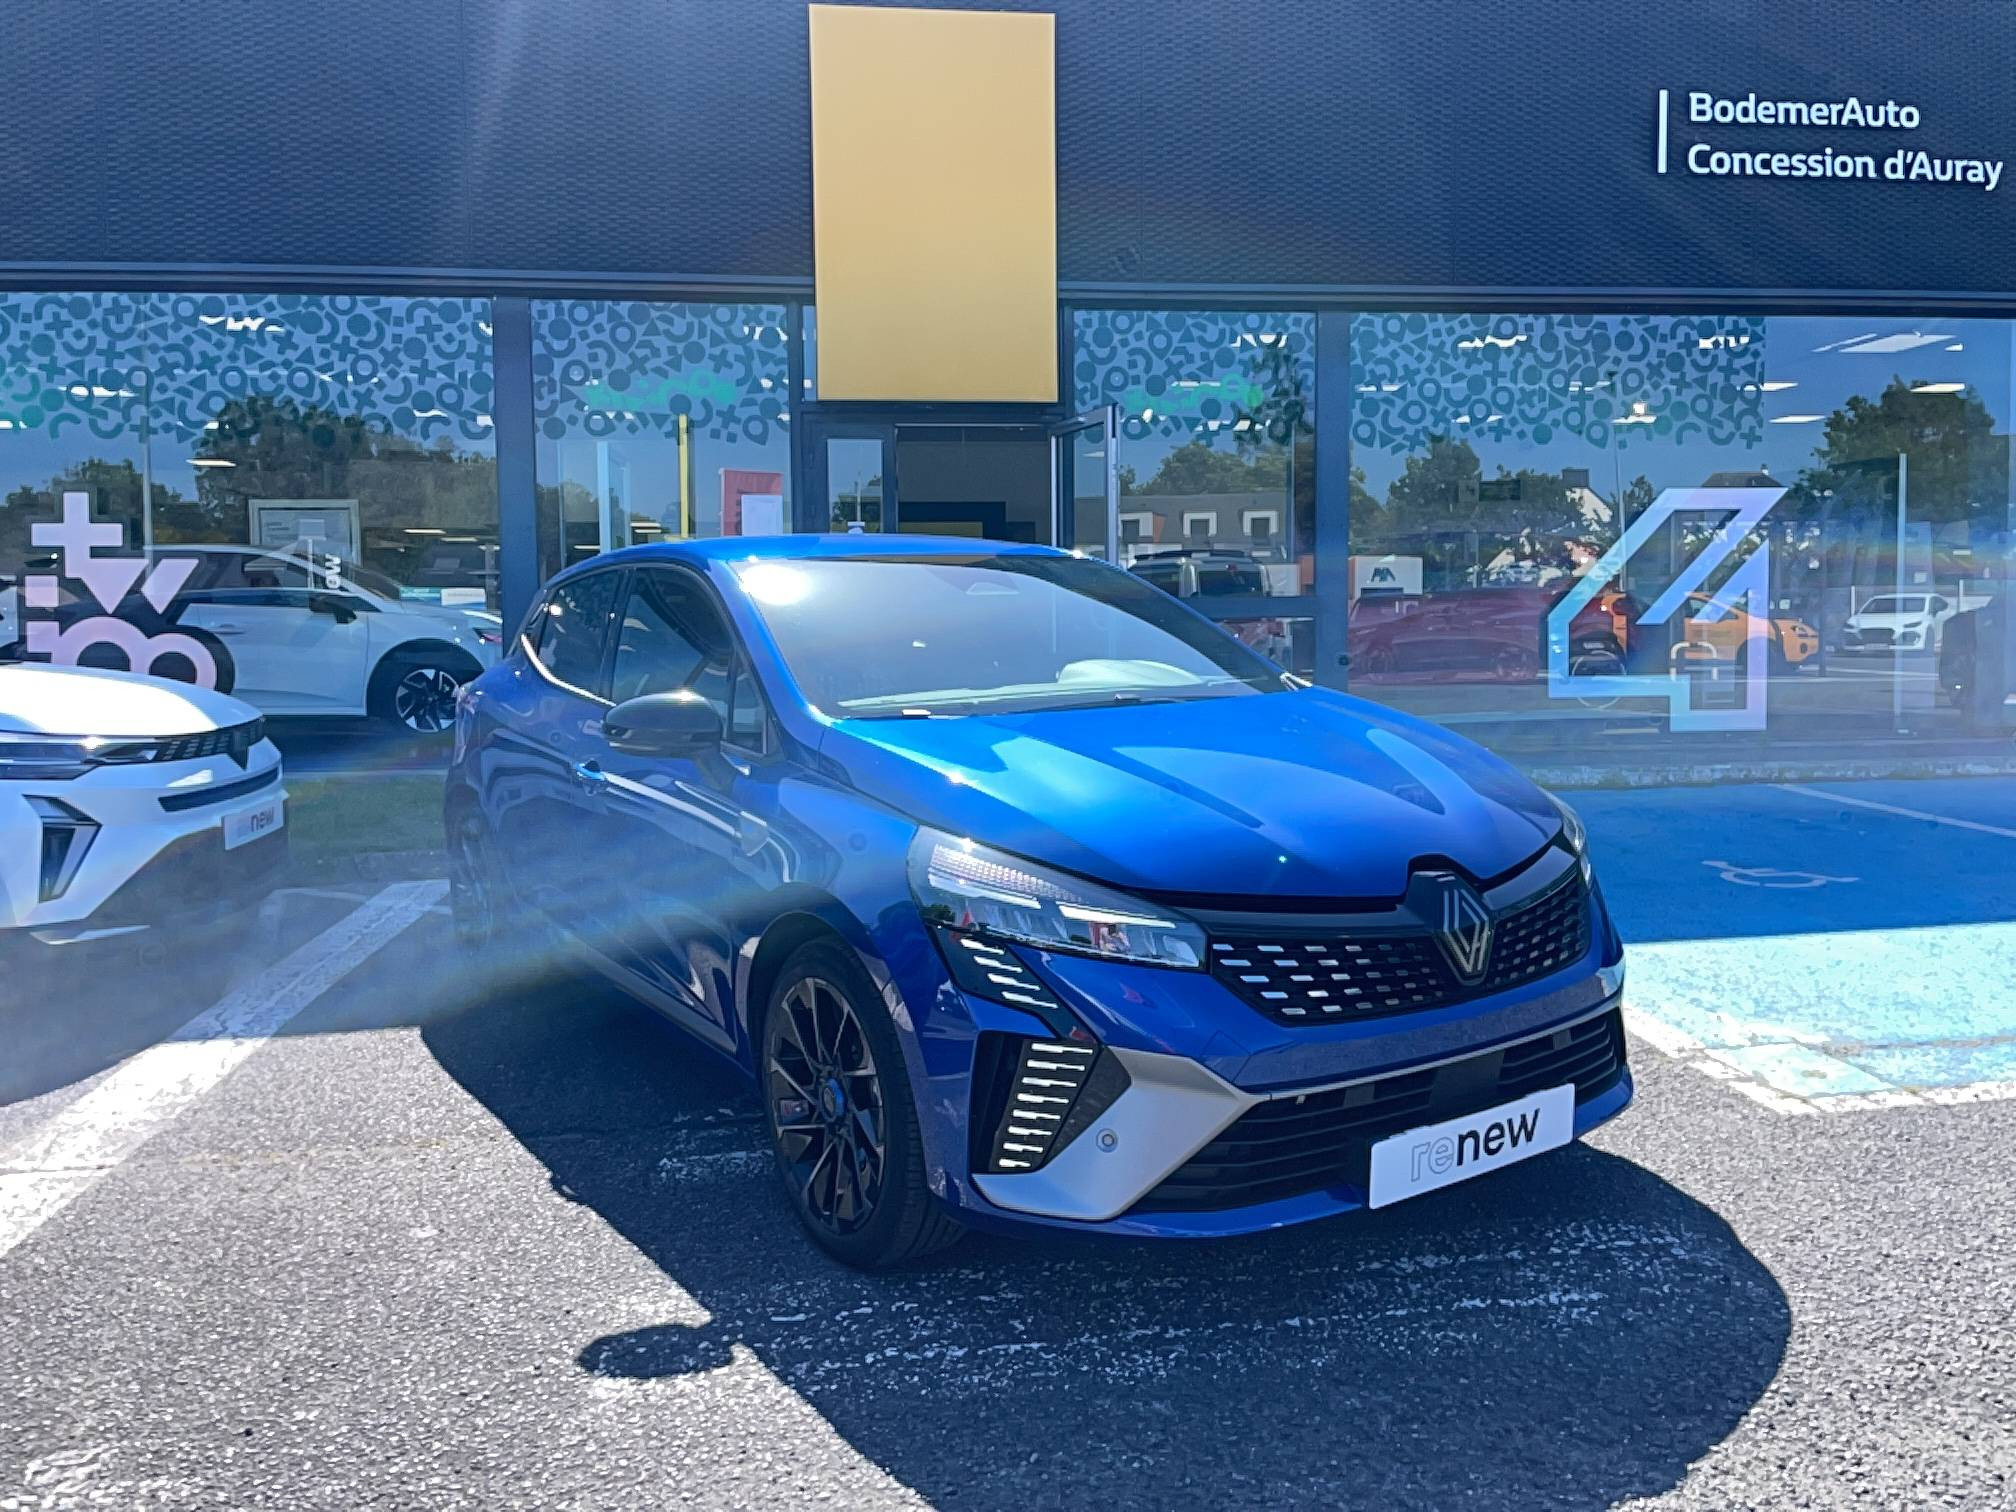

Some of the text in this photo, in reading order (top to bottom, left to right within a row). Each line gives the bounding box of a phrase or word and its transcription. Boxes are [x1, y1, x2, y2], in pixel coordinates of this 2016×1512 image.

[1689, 92, 1920, 128] BodemerAuto
[1688, 144, 2004, 191] Concession d'Auray
[1411, 1108, 1541, 1182] renew
